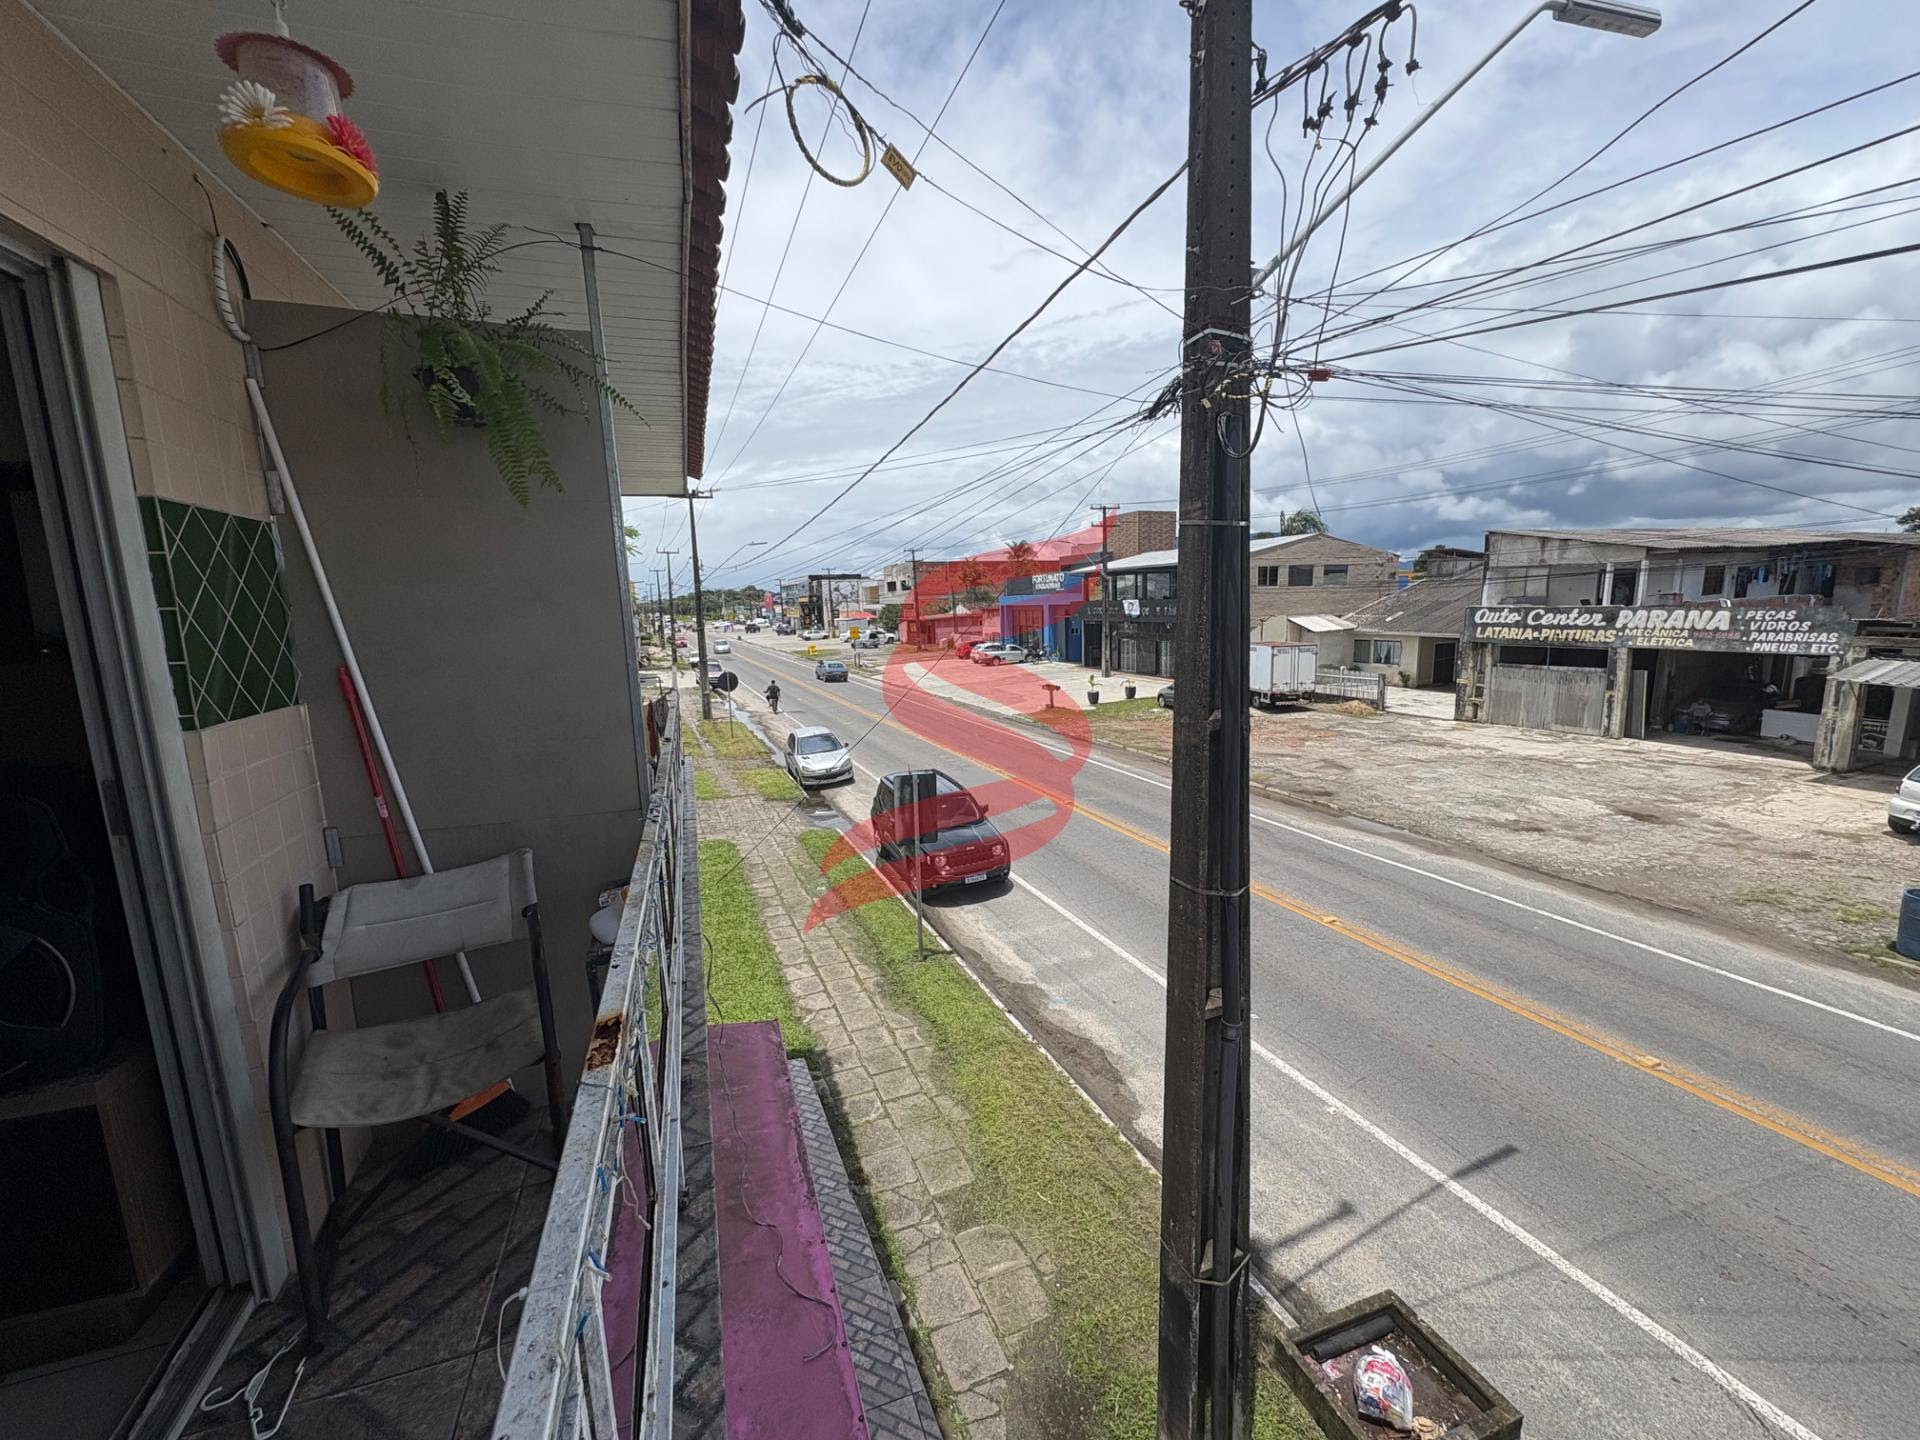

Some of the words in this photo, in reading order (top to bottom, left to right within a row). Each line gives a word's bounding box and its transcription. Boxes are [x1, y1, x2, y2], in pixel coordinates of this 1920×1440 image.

[1474, 608, 1522, 624] Auto
[1527, 609, 1607, 626] Center
[1745, 610, 1797, 621] PEÇAS
[1750, 621, 1812, 631] VIDROS
[1475, 626, 1533, 640] LATARIA
[1540, 628, 1617, 643] PINTURAS
[1749, 632, 1839, 643] PARABRISAS
[1810, 644, 1844, 655] ETC.
